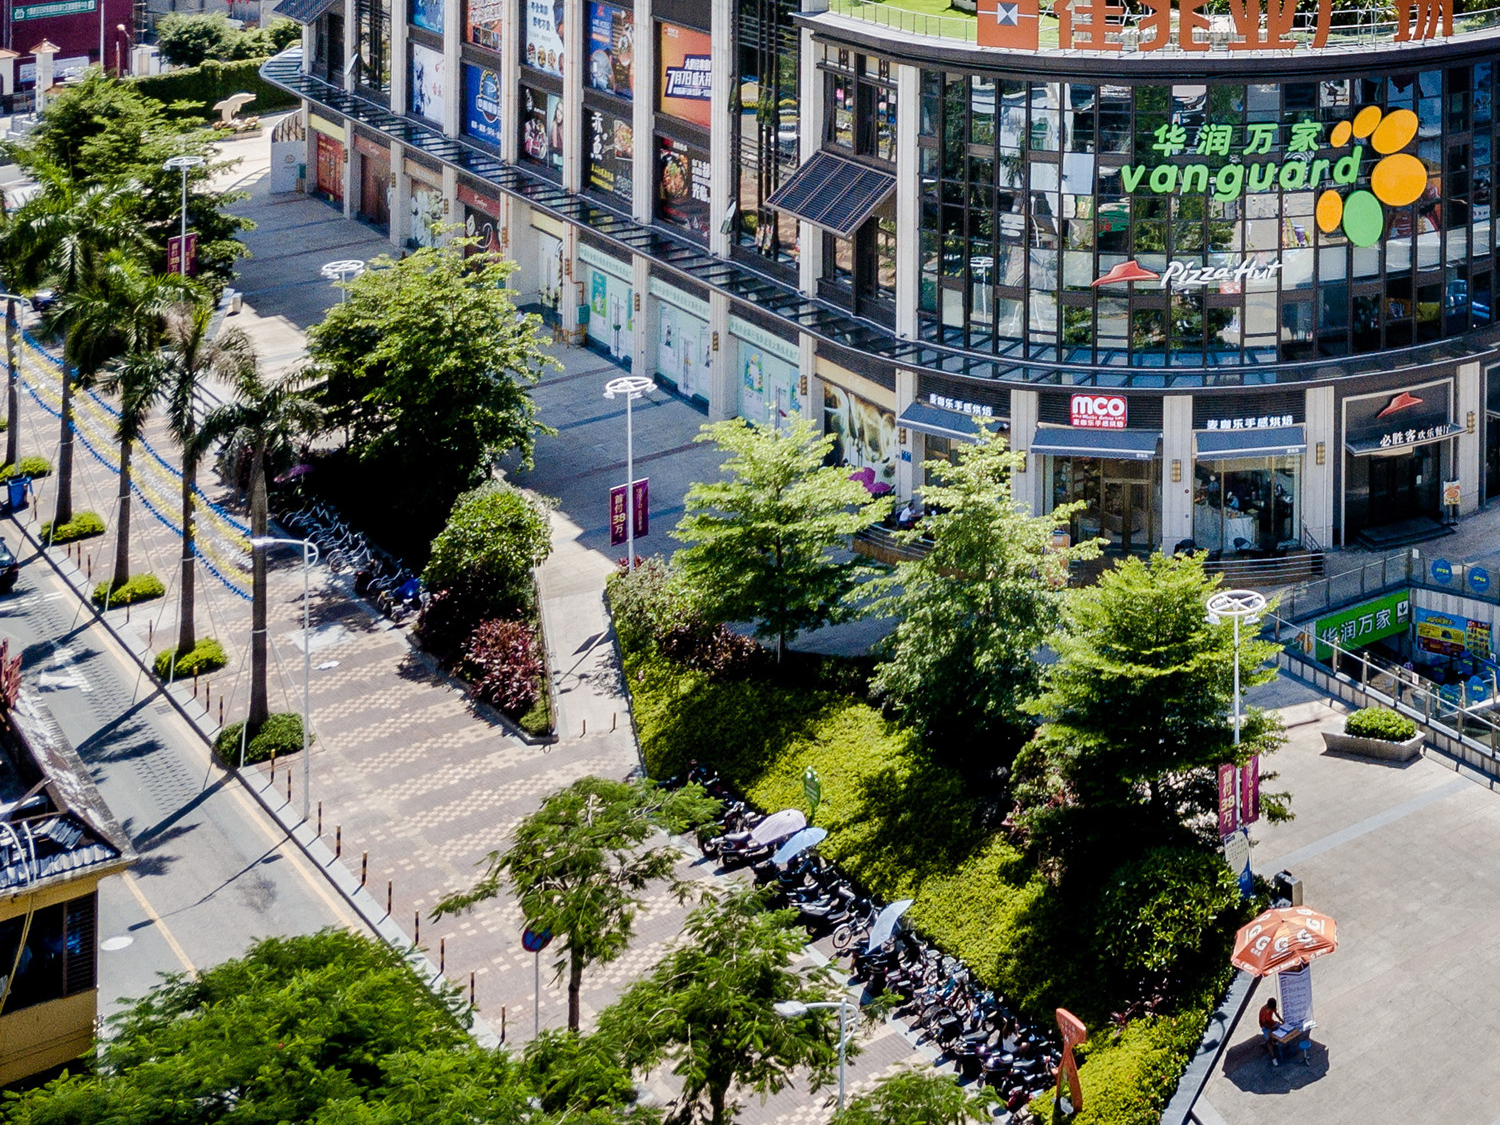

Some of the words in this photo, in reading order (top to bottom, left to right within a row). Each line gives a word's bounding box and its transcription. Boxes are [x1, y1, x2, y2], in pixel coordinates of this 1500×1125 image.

[1153, 121, 1323, 155] 华润万家
[1121, 146, 1363, 202] vanguard
[1160, 260, 1231, 286] Pizza
[1232, 260, 1287, 282] Hut
[1321, 608, 1392, 648] 华润万家
